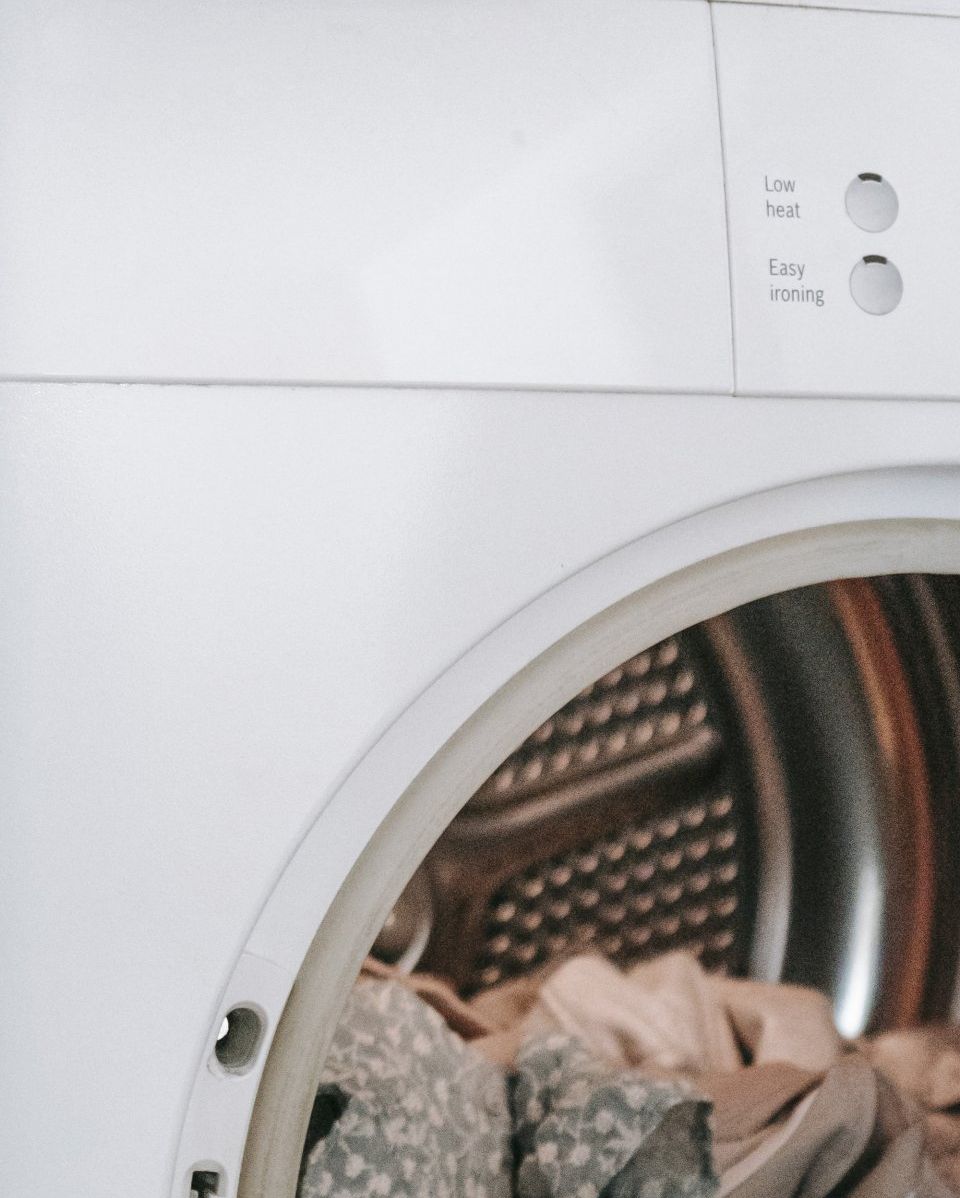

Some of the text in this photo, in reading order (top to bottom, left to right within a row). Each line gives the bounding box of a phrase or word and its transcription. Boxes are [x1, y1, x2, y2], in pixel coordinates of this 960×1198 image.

[765, 176, 795, 192] Low
[766, 201, 800, 218] heat
[770, 259, 805, 278] Easy
[770, 285, 824, 307] ironing
